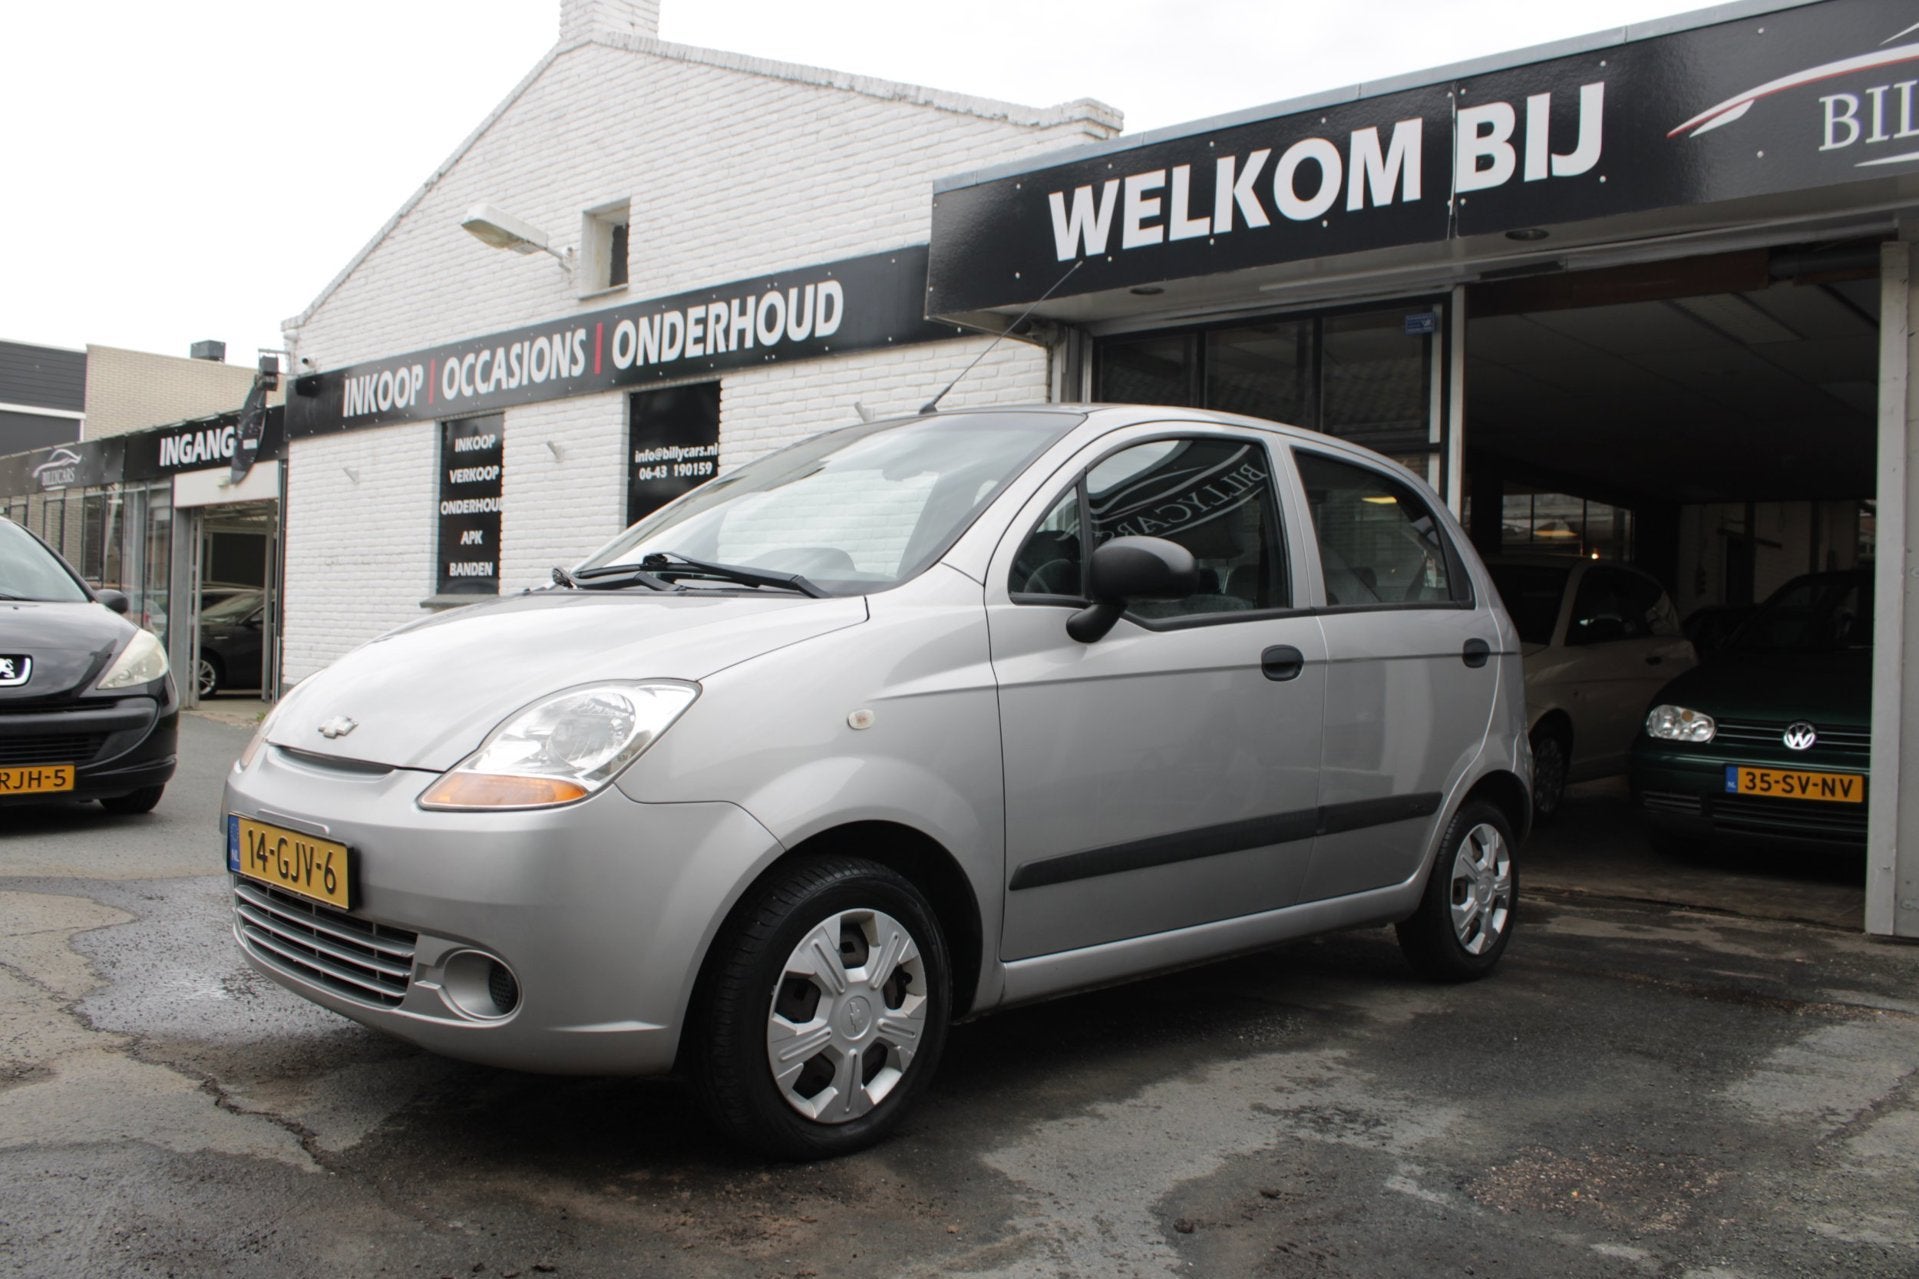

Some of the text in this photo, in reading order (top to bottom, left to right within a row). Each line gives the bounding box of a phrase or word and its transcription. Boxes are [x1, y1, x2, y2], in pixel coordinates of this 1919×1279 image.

[1048, 81, 1605, 262] WELKOM BIJ
[343, 279, 844, 418] INKOOP OCCASIONS ONDERHOUD
[159, 425, 235, 467] INGANG
[455, 434, 496, 452] INKOOP
[635, 442, 718, 463] info@billycars.nl
[450, 465, 499, 483] VERKOOP
[639, 461, 713, 480] 06-43 190159
[441, 497, 502, 515] ONDERHOU
[460, 530, 483, 545] APK
[449, 561, 493, 577] BANDEN
[0, 769, 66, 791] RJH-5
[1744, 771, 1854, 798] 35-SV-NV
[248, 828, 337, 895] 14-GJV-6
